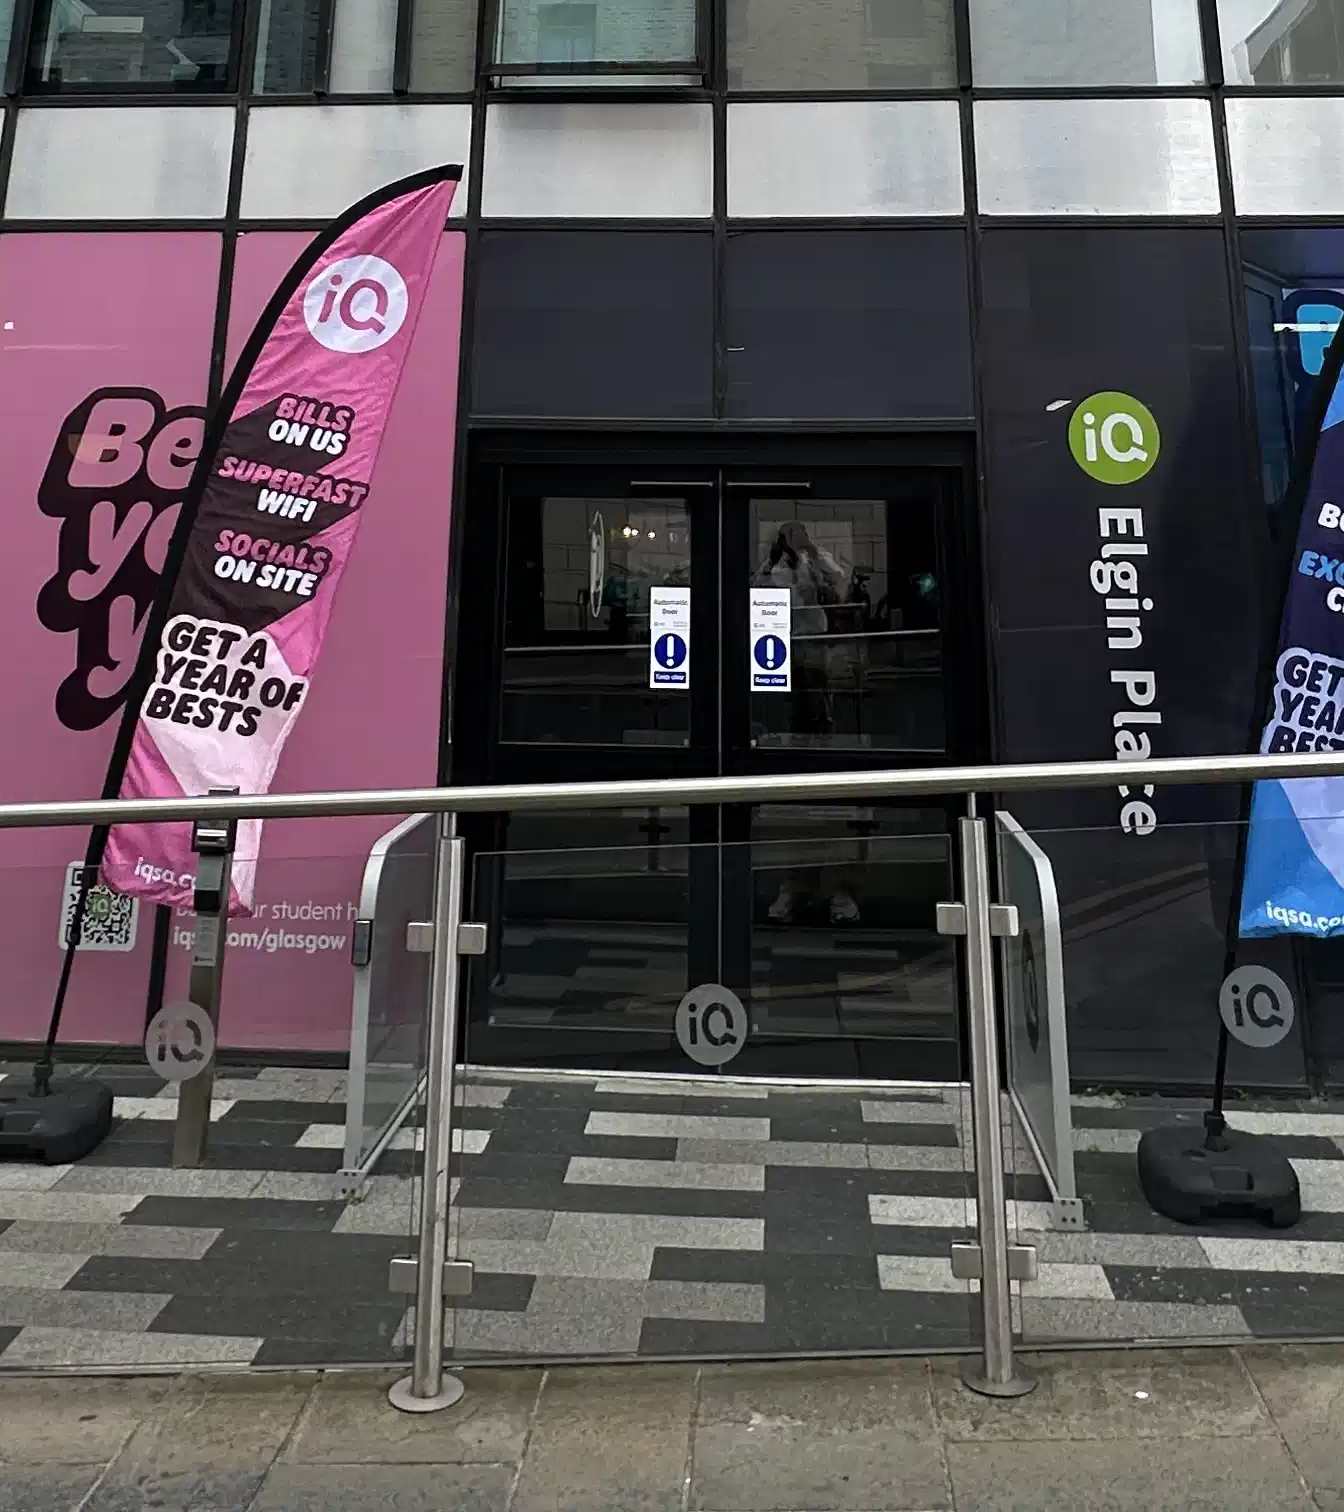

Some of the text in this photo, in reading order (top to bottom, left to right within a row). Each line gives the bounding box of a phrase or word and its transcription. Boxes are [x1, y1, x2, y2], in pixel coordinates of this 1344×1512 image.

[317, 274, 389, 335] iQ
[275, 397, 351, 431] BILLS
[268, 419, 347, 455] ON US
[1082, 412, 1148, 463] iQ
[218, 456, 367, 508] SUPERFAST
[257, 488, 317, 523] WIFI
[214, 529, 328, 573] SOCIALS
[214, 555, 318, 596] ON SITE
[167, 621, 267, 670] GET A
[161, 653, 305, 711] YEAR OF
[1090, 507, 1162, 836] Elgin Plae
[146, 687, 262, 737] BESTS
[134, 856, 196, 889] iqsa.c
[271, 899, 343, 921] student
[688, 1002, 738, 1047] iQ
[1230, 983, 1285, 1028] iQ
[157, 1019, 205, 1062] iQ
